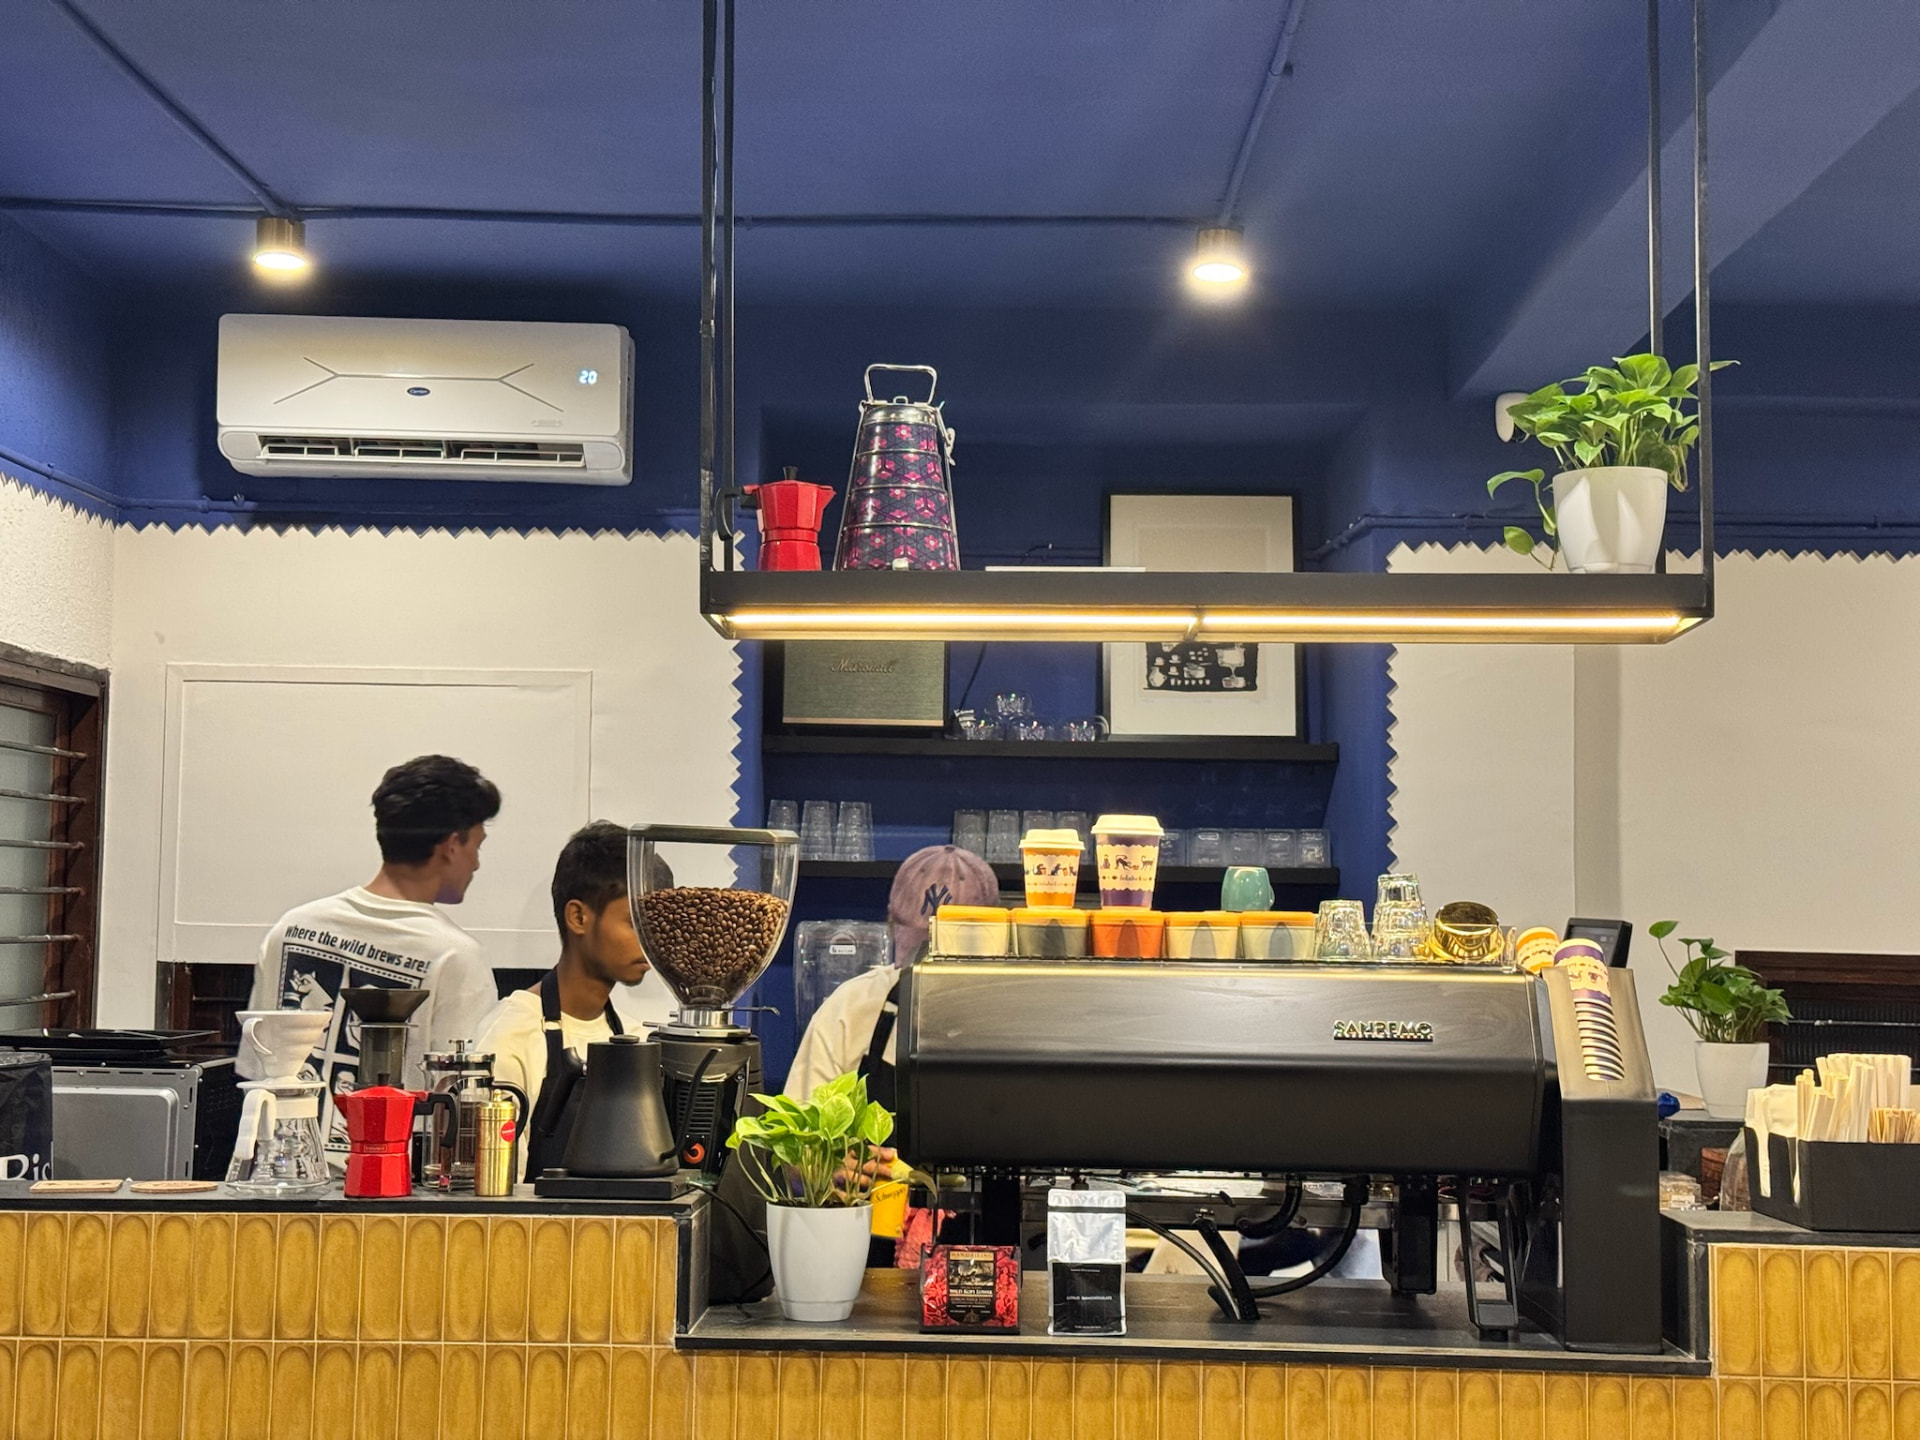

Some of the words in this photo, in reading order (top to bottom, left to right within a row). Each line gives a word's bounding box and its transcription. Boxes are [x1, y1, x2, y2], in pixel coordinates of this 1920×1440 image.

[578, 369, 598, 385] 20
[284, 924, 317, 942] where
[318, 931, 338, 948] the
[339, 938, 368, 956] wild
[368, 945, 403, 965] brews
[403, 957, 432, 974] are!
[1333, 1019, 1433, 1040] SANREMO
